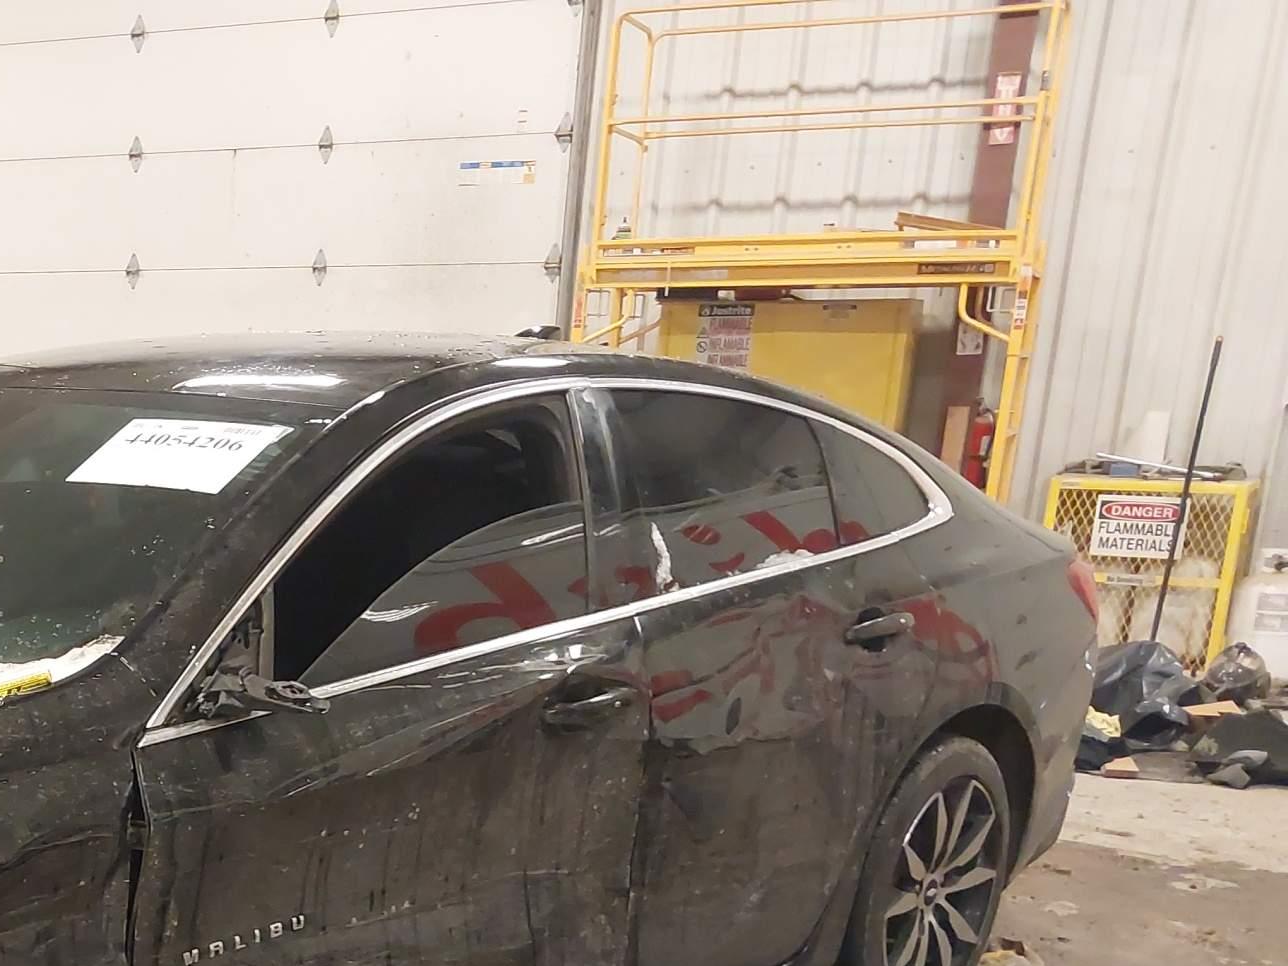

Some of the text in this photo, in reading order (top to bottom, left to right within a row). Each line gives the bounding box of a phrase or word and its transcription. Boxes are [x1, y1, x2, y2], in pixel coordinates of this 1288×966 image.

[125, 432, 244, 452] 44054206
[1111, 504, 1174, 518] DANGER
[1098, 521, 1173, 537] FLAMMABL
[182, 914, 305, 966] MALIBU
